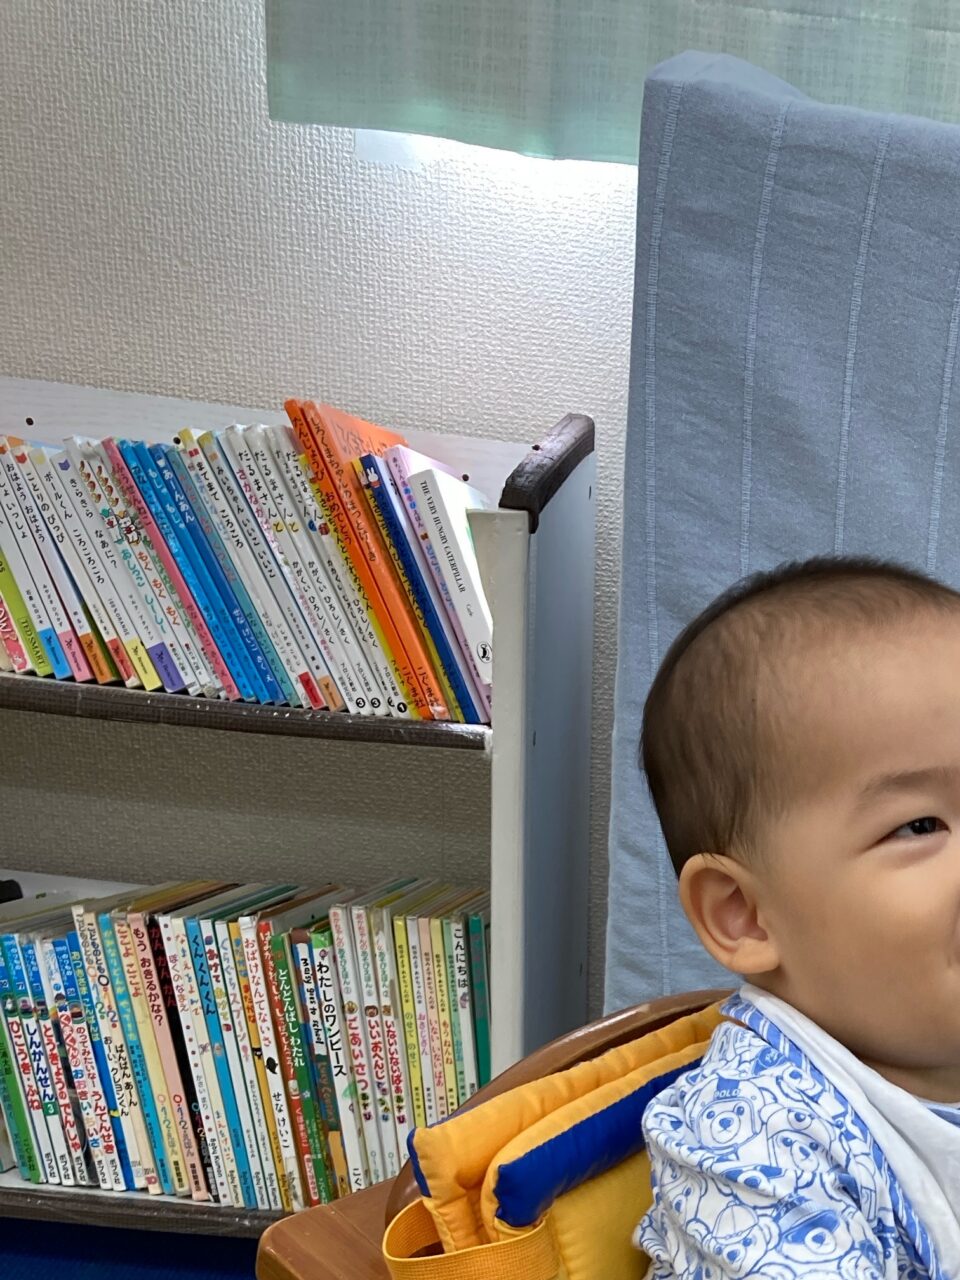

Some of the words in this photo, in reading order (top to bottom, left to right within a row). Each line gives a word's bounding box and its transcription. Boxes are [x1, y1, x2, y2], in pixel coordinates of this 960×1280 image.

[6, 463, 27, 501] おはよう
[25, 504, 46, 543] おはよう
[27, 472, 50, 512] ことりの
[70, 479, 93, 518] きらきら
[162, 469, 195, 523] あーんあん
[196, 461, 221, 502] まてまて
[220, 509, 244, 549] ころころ
[43, 472, 72, 520] ボールくん
[71, 529, 105, 585] ころころころ
[242, 518, 260, 546] いいこ
[258, 551, 276, 578] いいこ
[421, 481, 430, 495] THE
[426, 496, 437, 515] VERY
[434, 516, 448, 544] HUNGRY
[444, 545, 466, 592] CATERPILLAR
[292, 560, 312, 593] かがくい
[308, 560, 327, 592] かがくい
[133, 927, 147, 952] もう
[206, 947, 223, 983] あけて
[453, 928, 469, 989] こんにちは
[168, 953, 189, 1013] ぼくのなまえ
[244, 937, 272, 1047] おばけなんてないさ
[278, 968, 298, 1033] どんどんばし
[290, 1036, 305, 1068] わたれ
[316, 961, 347, 1077] わたしのワンピース
[9, 1019, 42, 1111] ひこうき・ふね
[25, 1022, 54, 1103] しんかんせん
[43, 1024, 67, 1100] とうきょうの
[60, 1102, 81, 1154] でんしゃ
[47, 1104, 55, 1114] 3
[90, 1089, 116, 1155] うんてんせき
[124, 1080, 138, 1108] あーん
[272, 1092, 284, 1113] せな
[277, 1117, 291, 1149] けいこ
